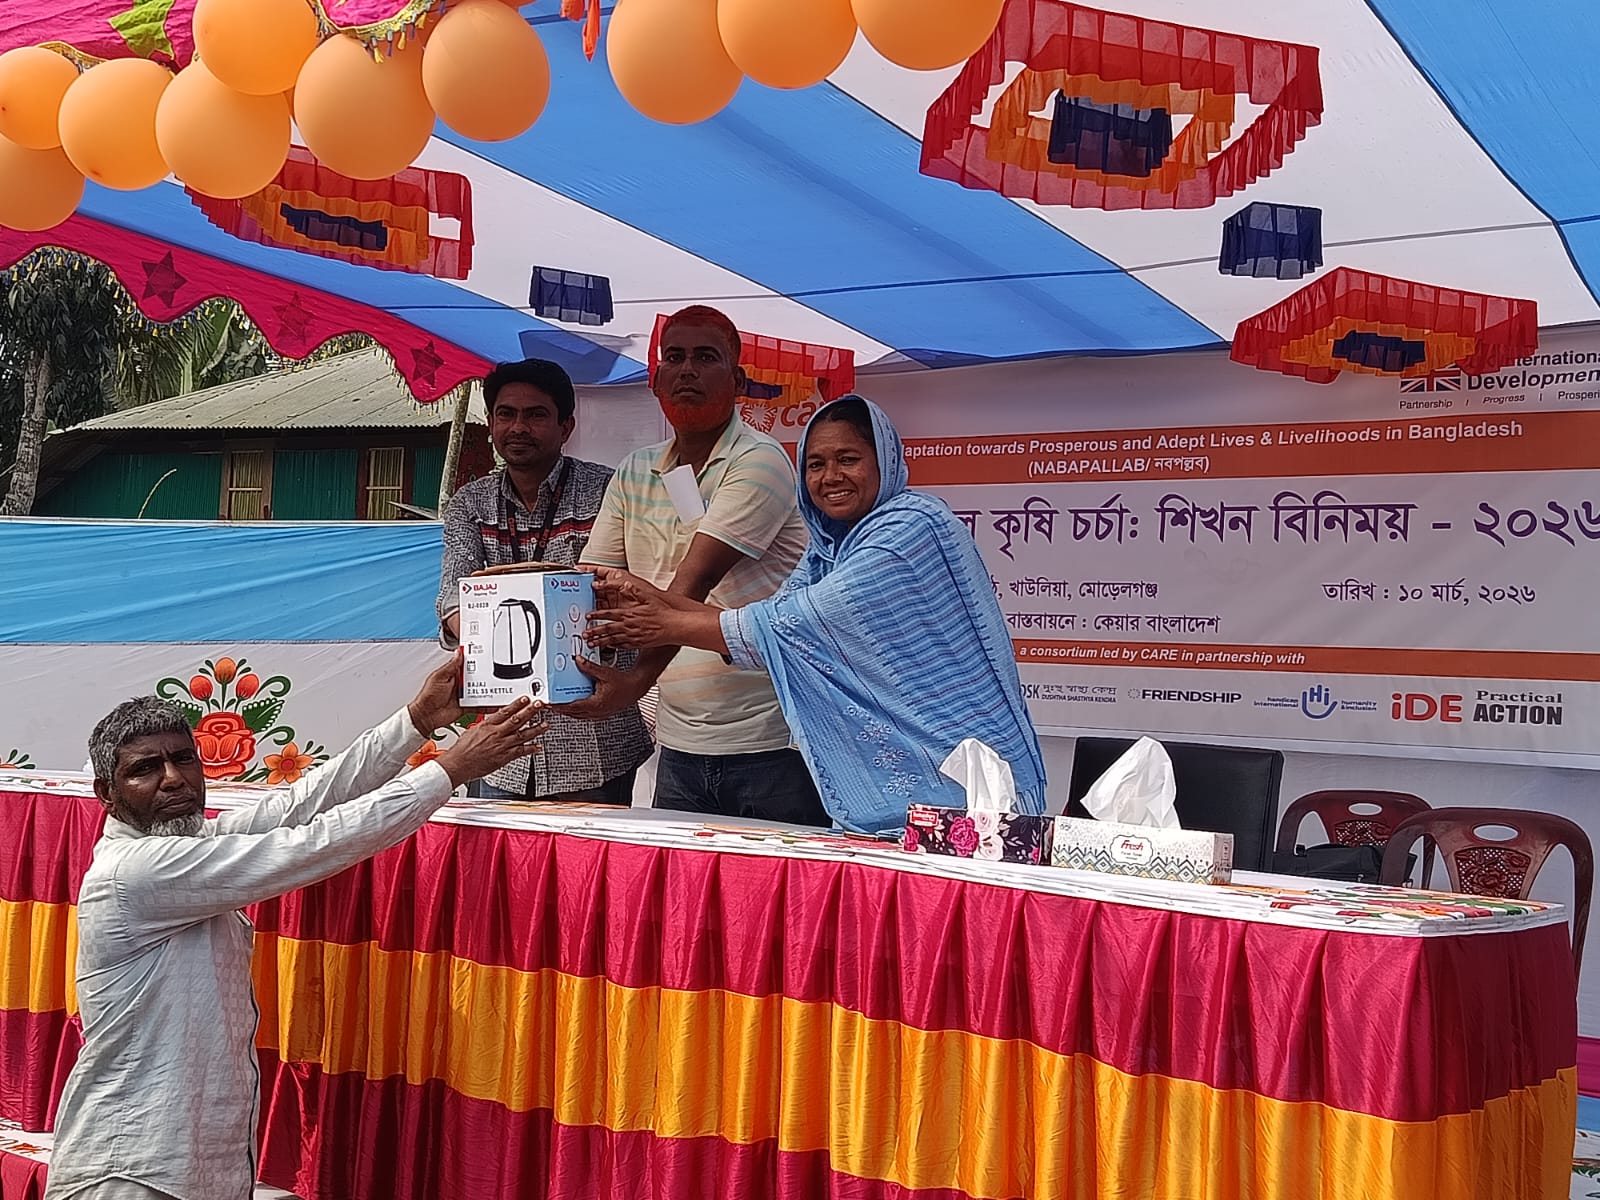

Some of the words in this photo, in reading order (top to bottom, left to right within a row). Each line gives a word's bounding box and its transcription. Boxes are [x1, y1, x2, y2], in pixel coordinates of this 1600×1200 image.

[1399, 400, 1453, 410] Partnership
[1483, 394, 1526, 405] Progress
[780, 401, 826, 427] ca
[902, 443, 962, 459] aptation
[966, 441, 1025, 455] towards
[1029, 438, 1118, 455] Prosperous
[1122, 435, 1152, 450] and
[1156, 434, 1205, 451] Adept
[1211, 432, 1255, 447] Lives
[1260, 432, 1273, 445] &
[1278, 427, 1381, 445] Livelihoods
[1386, 425, 1402, 440] in
[1408, 421, 1523, 442] Bangladesh
[990, 496, 1060, 562] কৃষি
[1155, 490, 1262, 545] শিখন
[1473, 500, 1600, 547] ২০২৬
[474, 583, 497, 591] BAJAJ
[1321, 578, 1377, 601] তারিখ
[1398, 584, 1423, 602] ১০
[1430, 577, 1470, 606] মার্চ,
[1478, 584, 1536, 604] ২০২৬
[1145, 615, 1222, 634] বাংলাদেশ
[1020, 647, 1027, 656] a
[1030, 646, 1097, 660] consortium
[1099, 647, 1119, 661] led
[1122, 648, 1138, 663] by
[1140, 649, 1178, 664] CARE
[1181, 649, 1194, 664] in
[1196, 650, 1273, 668] partnership
[1276, 652, 1306, 668] with
[1142, 689, 1242, 704] FRIENDSHIP
[1477, 690, 1562, 703] Practical
[1391, 692, 1462, 723] iDE
[1473, 704, 1562, 725] ACTION
[1120, 839, 1144, 851] Fresh
